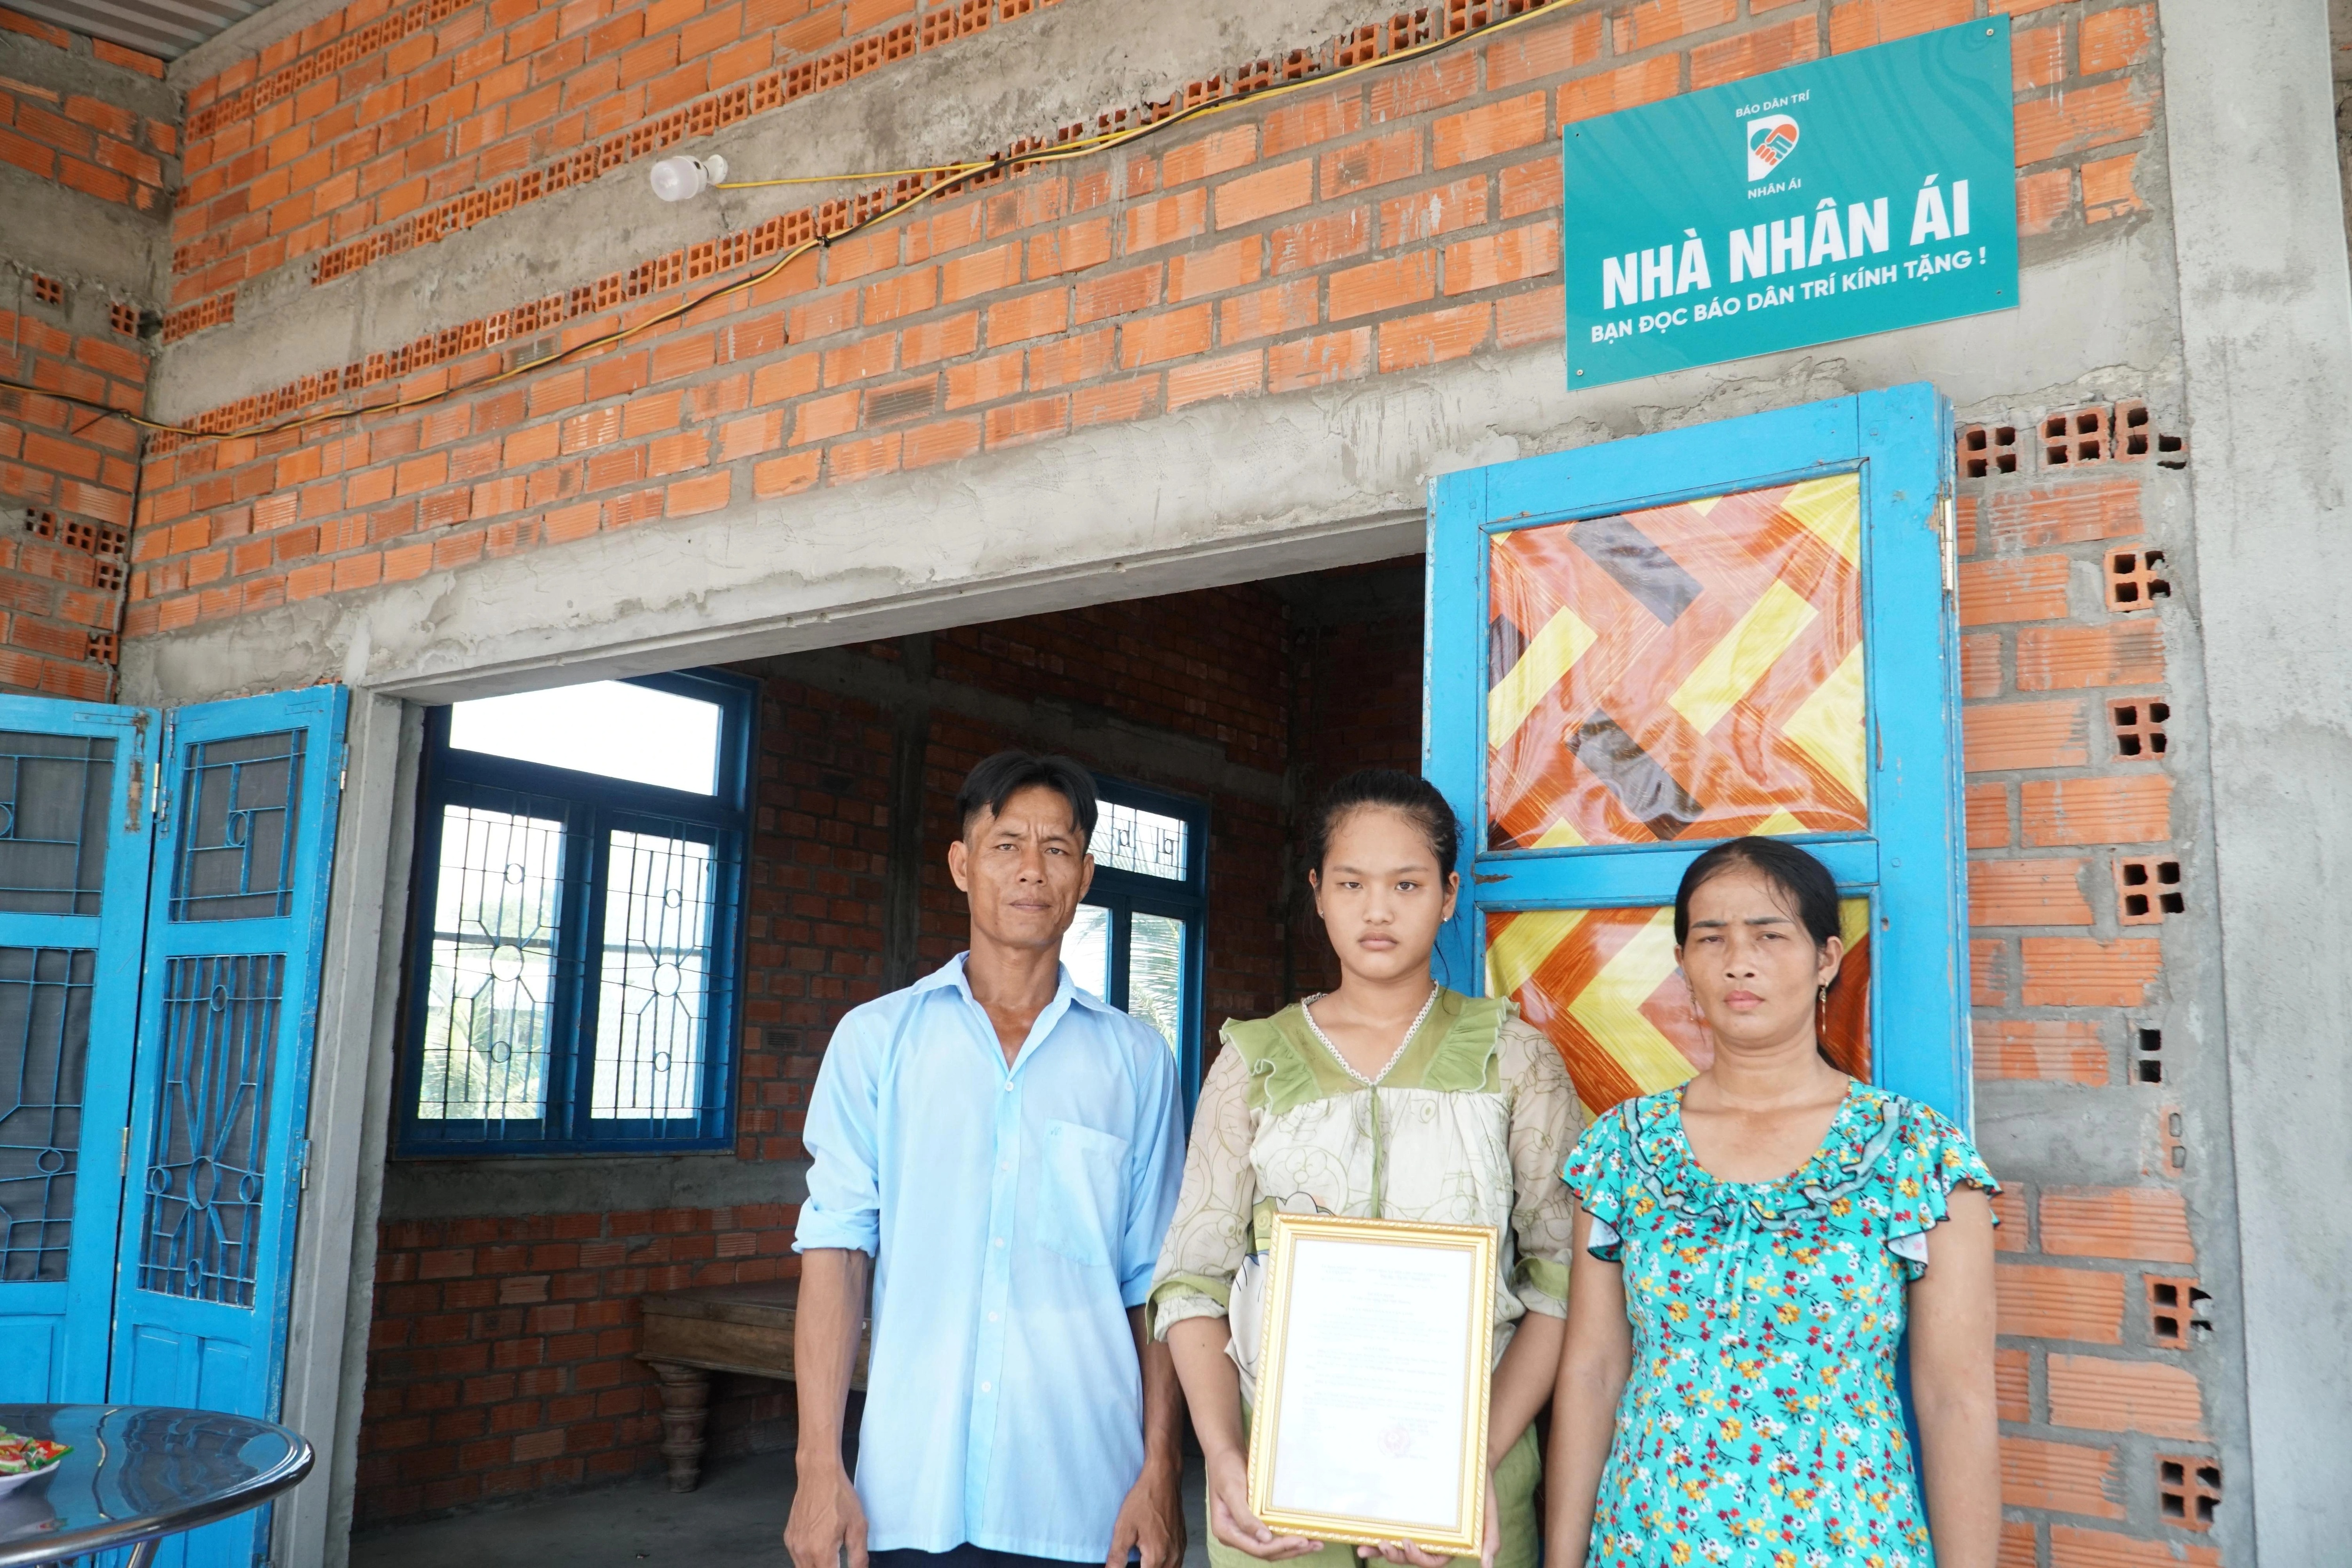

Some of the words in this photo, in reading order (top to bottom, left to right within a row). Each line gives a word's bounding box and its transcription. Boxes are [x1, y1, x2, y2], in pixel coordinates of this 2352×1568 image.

[1736, 104, 1760, 118] BÁO
[1764, 97, 1788, 111] DÂN
[1791, 89, 1810, 103] TRÍ
[1748, 182, 1786, 199] NHÂN
[1788, 177, 1801, 191] ÁI
[1603, 228, 1711, 310] NHÀ
[1729, 197, 1889, 283] NHÂN
[1910, 174, 1970, 246] ÁI
[1591, 319, 1632, 344] BẠN
[1638, 308, 1688, 334] ĐỌC
[1694, 297, 1740, 322] BÁO
[1747, 285, 1794, 311] DÂN
[1800, 272, 1836, 300] TRÍ
[1842, 264, 1897, 292] KÍNH
[1903, 250, 1972, 281] TẶNG
